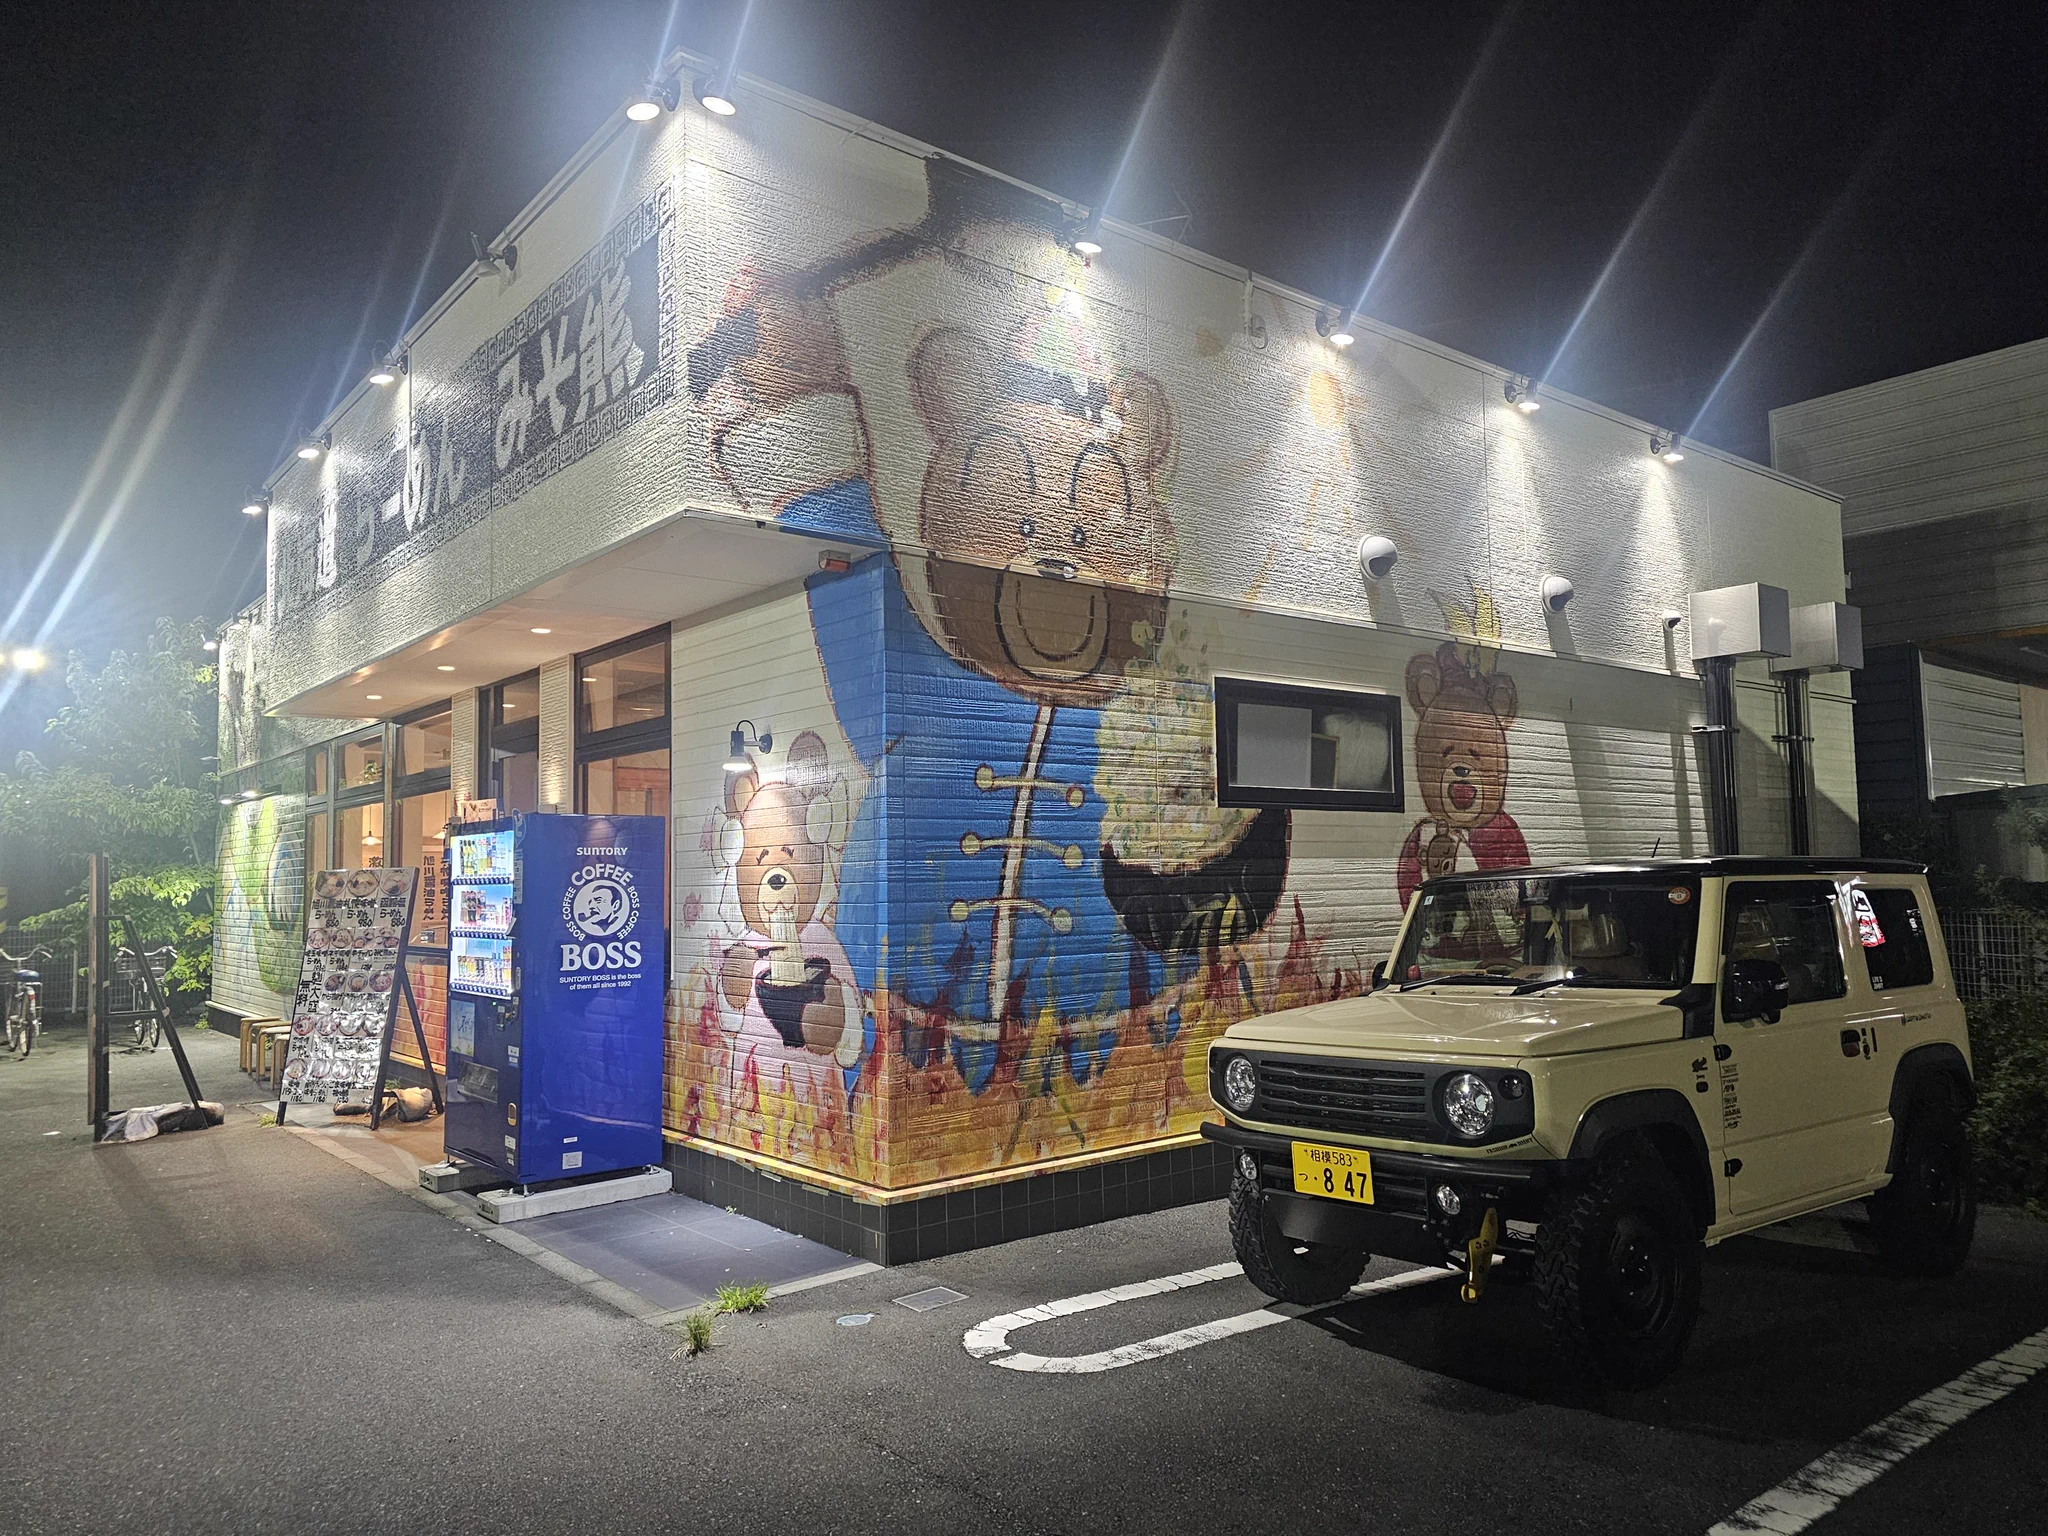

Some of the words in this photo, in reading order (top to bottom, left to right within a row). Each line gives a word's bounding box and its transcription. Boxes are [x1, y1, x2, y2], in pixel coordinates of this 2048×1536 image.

[576, 847, 628, 856] SUNTORY
[571, 863, 633, 886] COFFEE
[560, 941, 642, 972] BOSS
[560, 976, 591, 984] SUNTORY
[592, 974, 610, 982] BOSS
